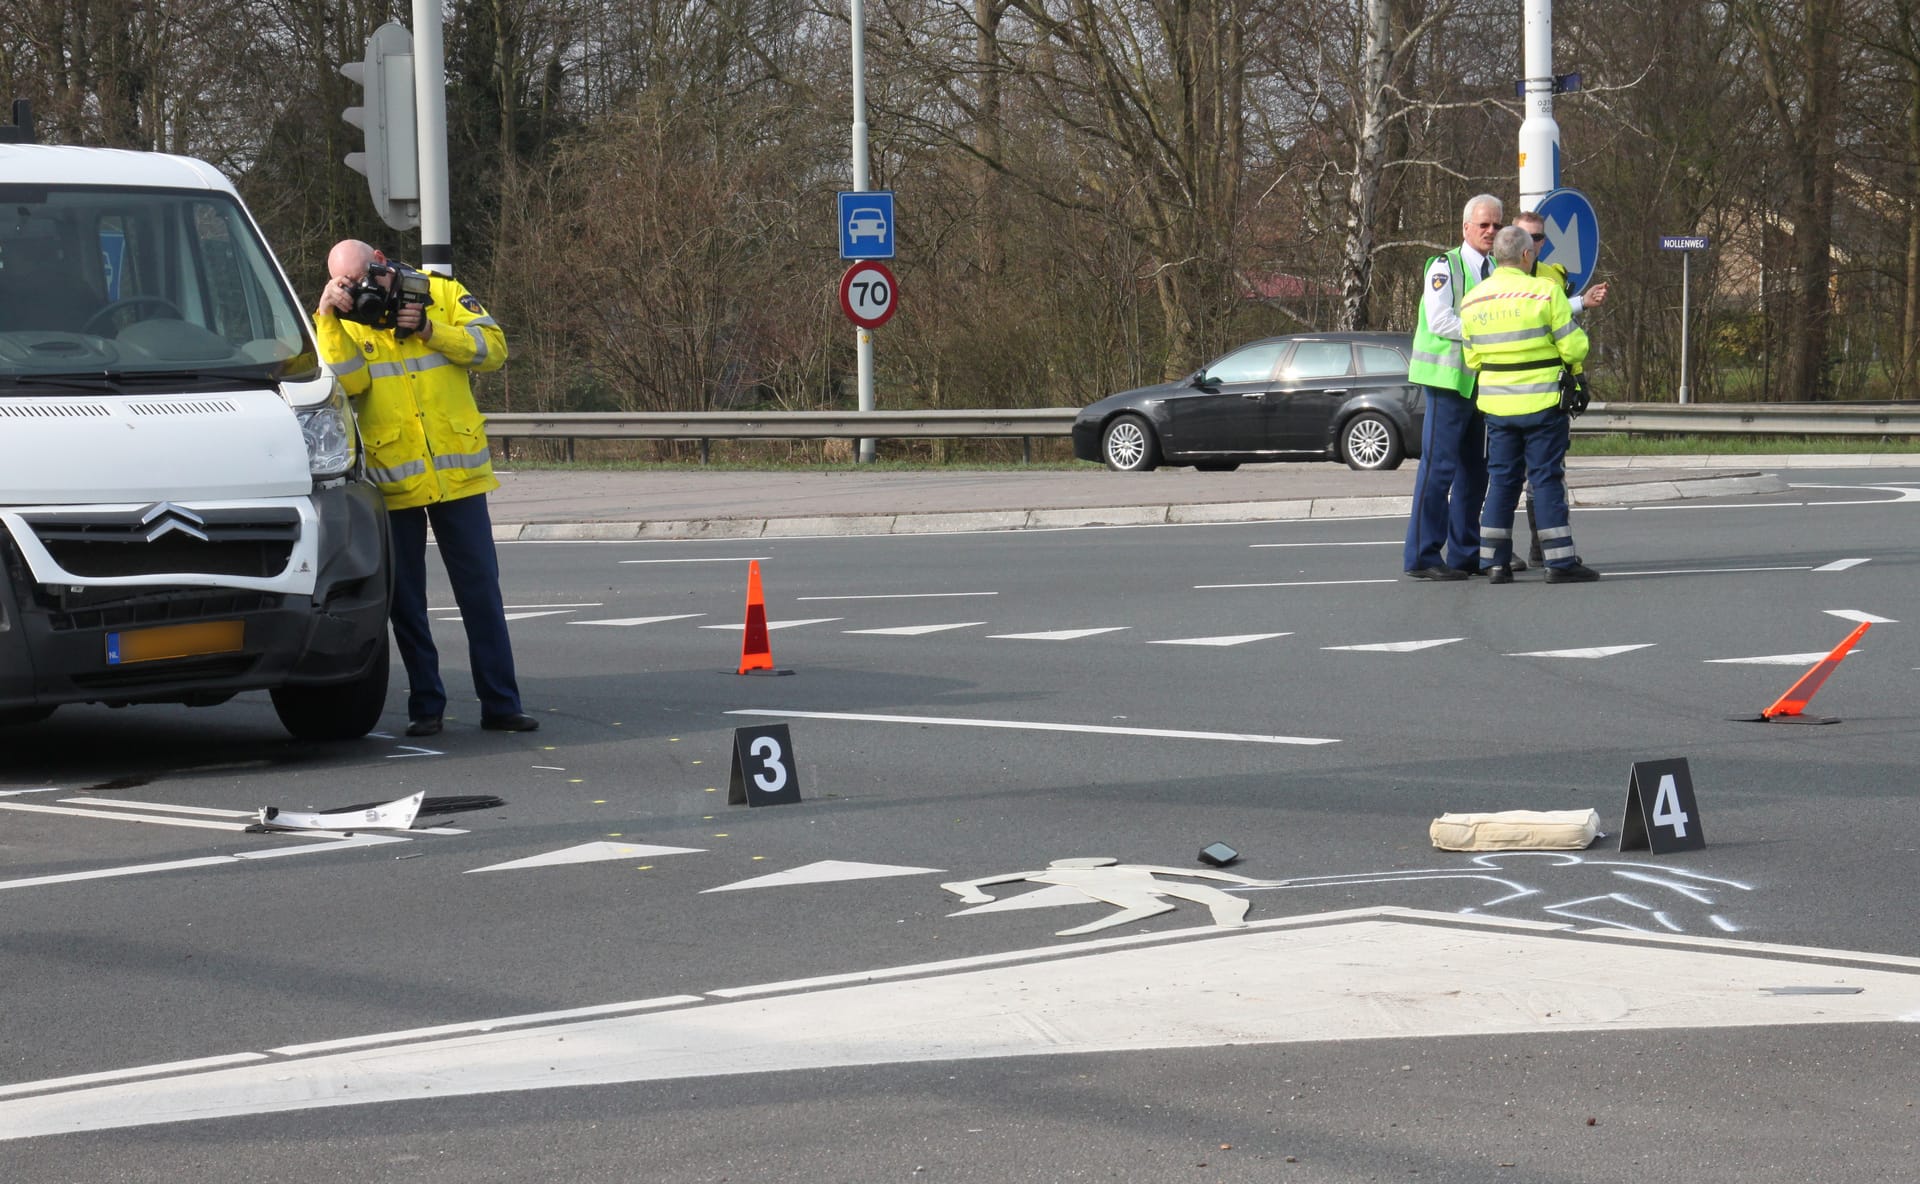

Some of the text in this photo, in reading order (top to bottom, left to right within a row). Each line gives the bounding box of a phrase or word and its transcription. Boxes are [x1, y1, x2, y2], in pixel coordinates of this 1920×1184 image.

[1663, 239, 1705, 249] NOLLENWEG
[852, 281, 888, 307] 70
[1472, 308, 1521, 326] POLITIE
[108, 651, 119, 660] NL
[750, 736, 788, 793] 3
[1652, 774, 1689, 839] 4
